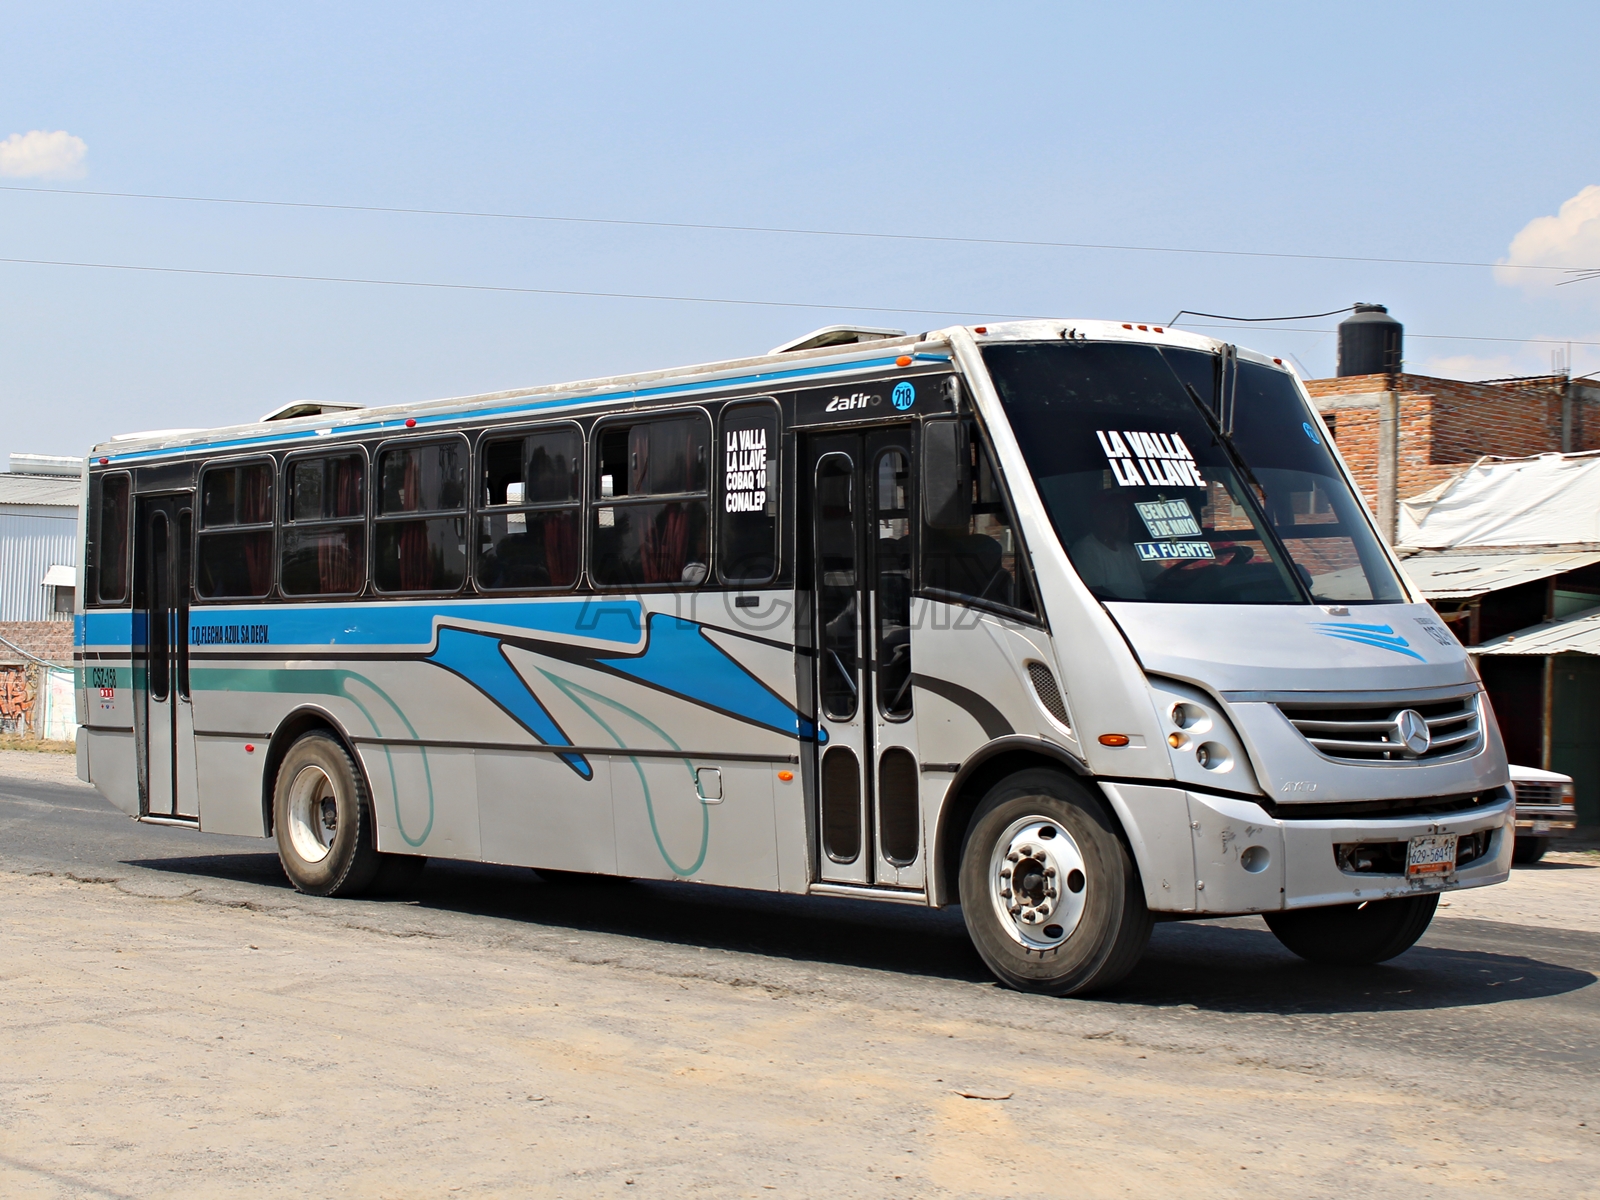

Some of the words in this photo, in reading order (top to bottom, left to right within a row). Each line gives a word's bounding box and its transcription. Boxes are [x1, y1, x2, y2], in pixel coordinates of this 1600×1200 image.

[895, 388, 911, 406] 218
[726, 431, 738, 451] LA
[739, 428, 766, 450] VALLA
[1096, 430, 1131, 457] LA
[1123, 430, 1194, 460] VALLA
[726, 451, 738, 472] LA
[739, 449, 767, 471] LLAVE
[726, 471, 755, 490] COBAQ
[756, 470, 766, 489] 10
[1108, 459, 1146, 486] LA
[1138, 459, 1207, 486] LLAVE
[726, 491, 766, 513] CONALEP
[1139, 502, 1190, 520] CENTRO
[1147, 521, 1160, 536] 5
[1155, 521, 1173, 535] DE
[1168, 518, 1199, 534] MAYO
[1138, 544, 1160, 558] LA
[1159, 543, 1213, 558] FUENTE
[224, 625, 240, 644] AZUL
[241, 625, 250, 644] SA
[100, 688, 114, 698] 911
